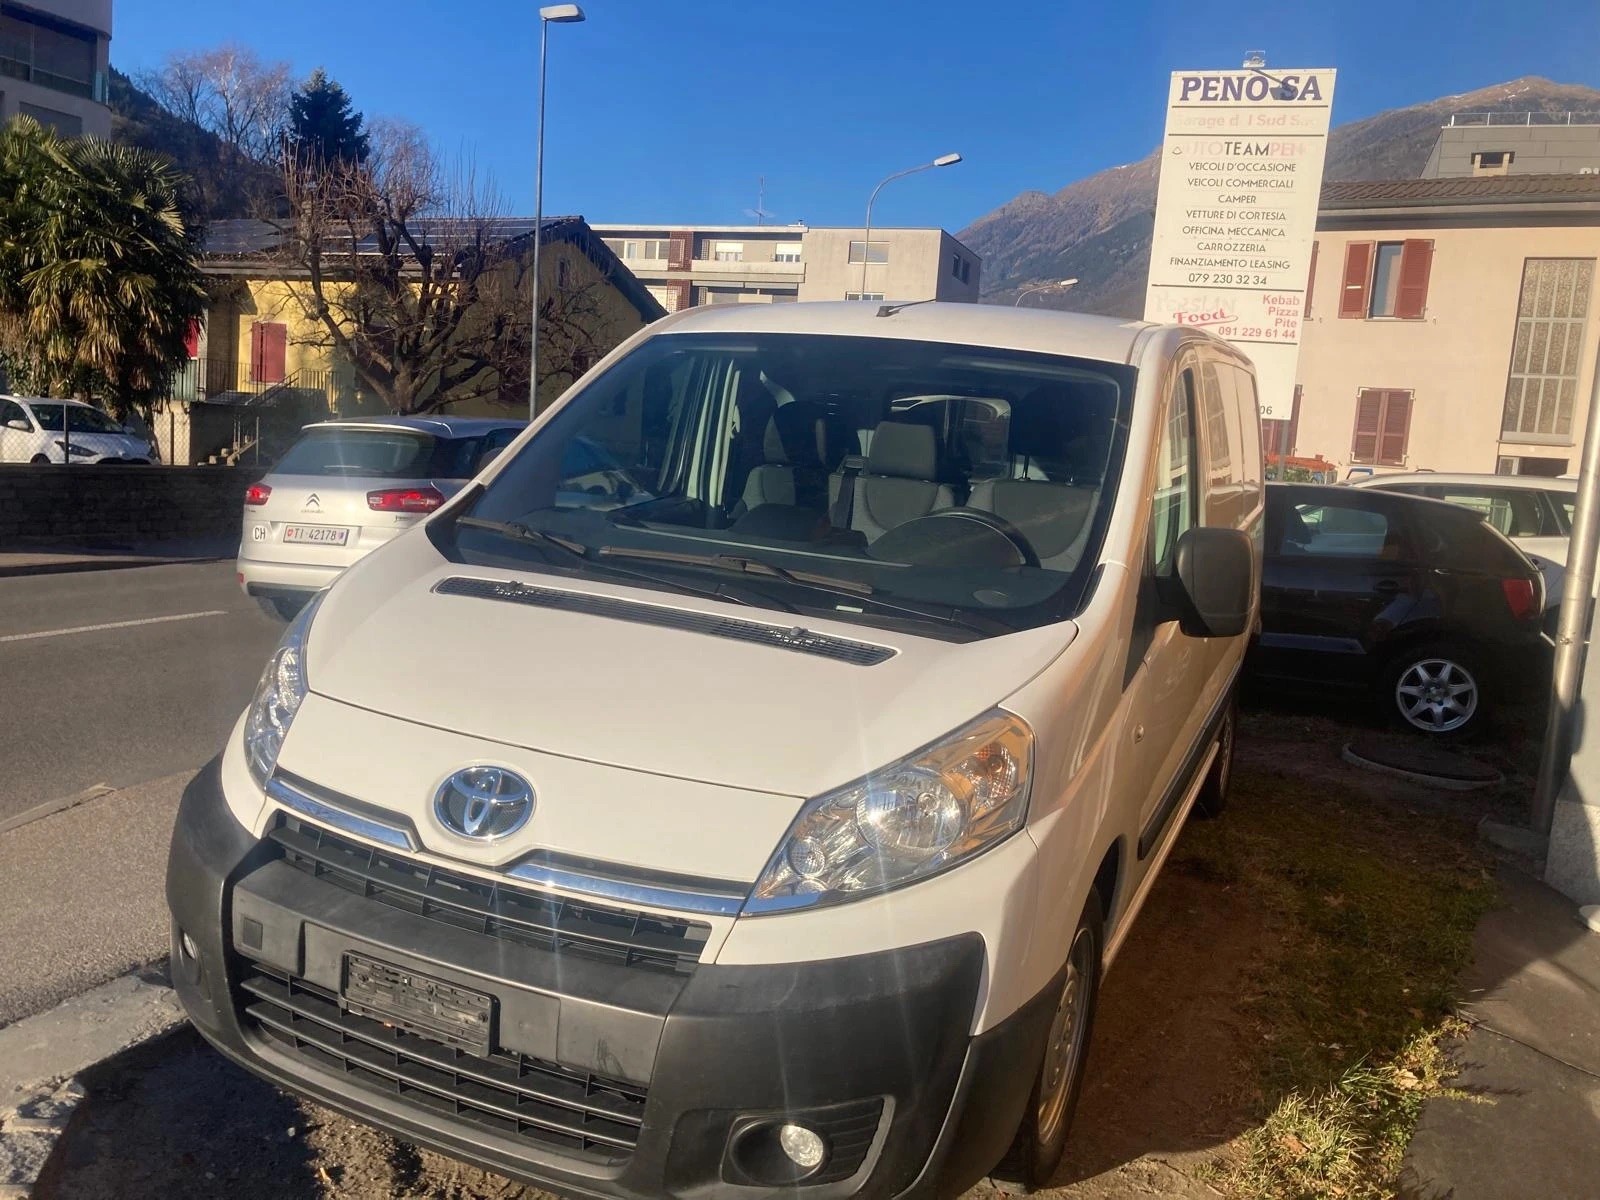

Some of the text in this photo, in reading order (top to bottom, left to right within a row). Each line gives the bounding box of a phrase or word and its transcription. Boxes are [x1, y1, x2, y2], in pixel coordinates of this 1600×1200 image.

[1179, 75, 1269, 101] PENO
[1179, 113, 1225, 129] arage
[1256, 113, 1287, 127] Sud
[1189, 162, 1297, 172] VEICOLI D'OCCASIONE
[1188, 178, 1294, 189] VEICOLI COMMERCIALI
[1218, 194, 1257, 204] CAMPER
[1186, 210, 1286, 221] VETTURE DI CORTESIA
[1182, 226, 1286, 237] OFFICINA MECCANICA
[1197, 242, 1266, 252] CARROZZERIA
[1170, 257, 1290, 270] FINANZIAMENTO LEASING
[1188, 273, 1267, 286] 079 230 32 34
[1262, 294, 1300, 306] Kebab
[1172, 308, 1228, 325] Food
[1268, 306, 1299, 317] Pizza
[1274, 318, 1297, 328] Pite
[1218, 326, 1296, 339] 091 229 61 44
[254, 527, 266, 540] CH
[308, 529, 337, 540] 42178
